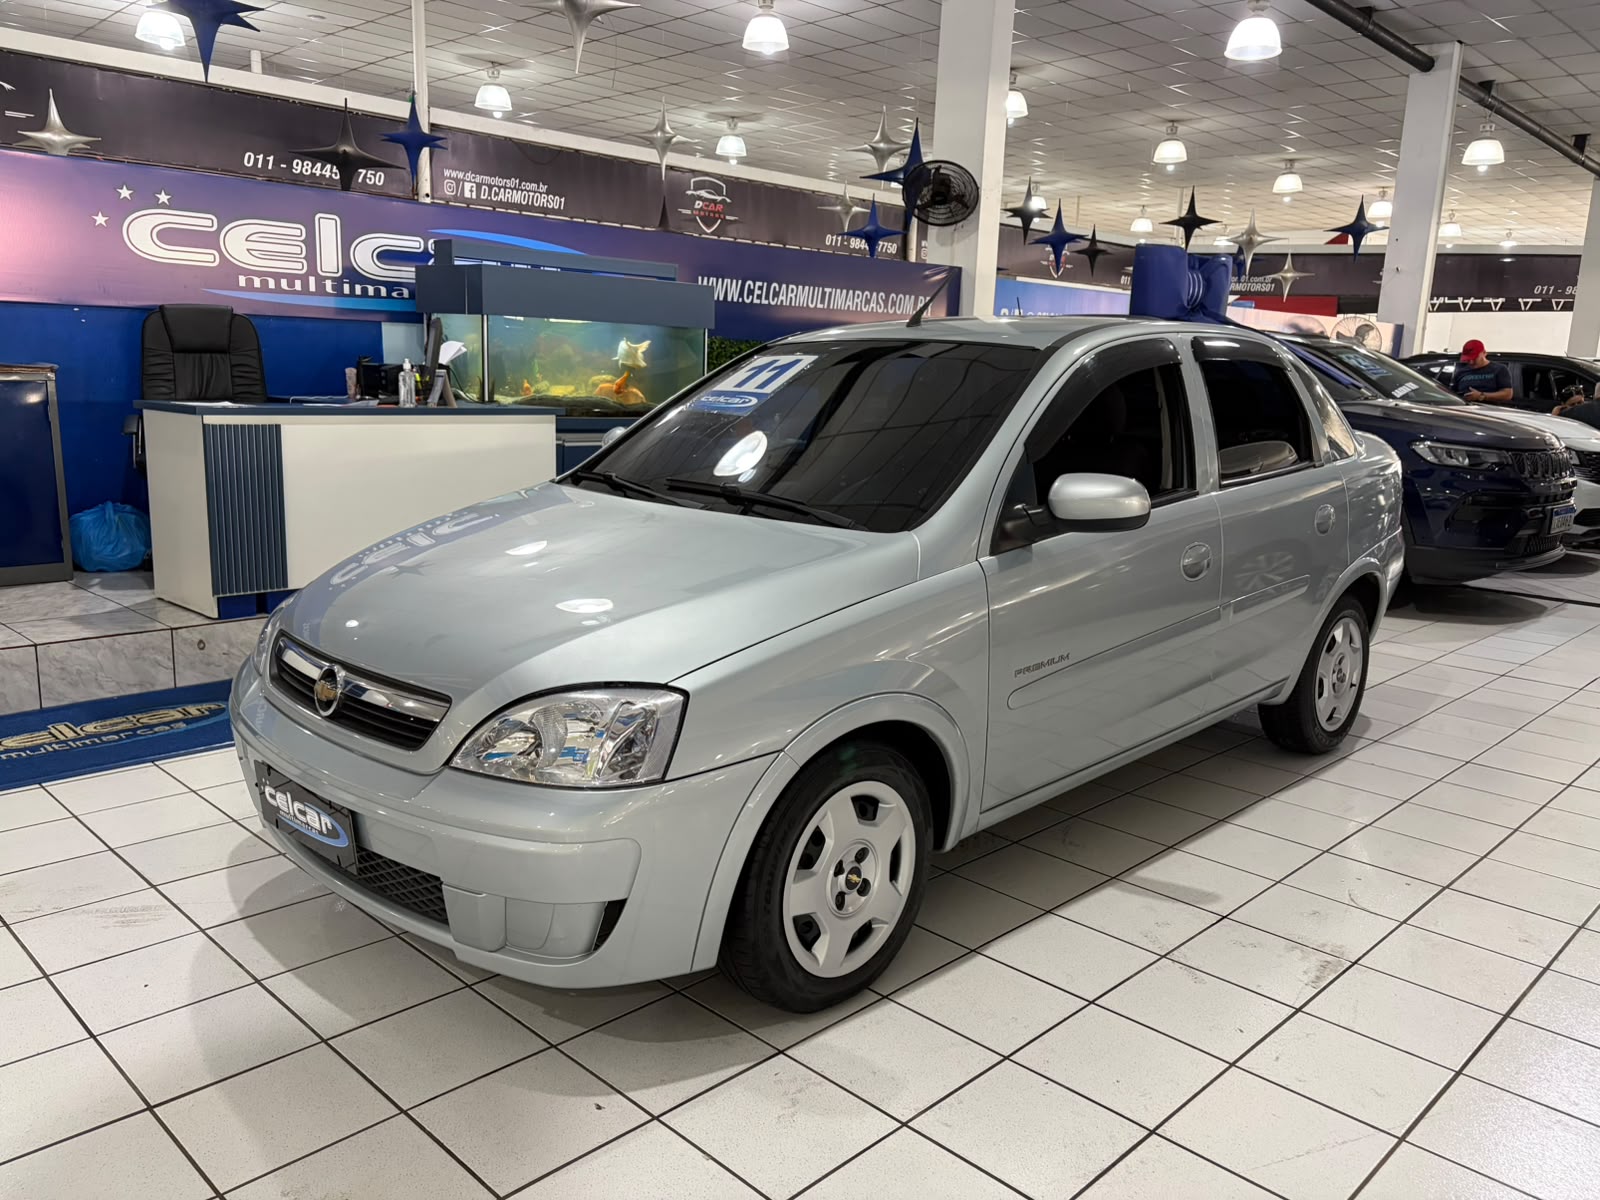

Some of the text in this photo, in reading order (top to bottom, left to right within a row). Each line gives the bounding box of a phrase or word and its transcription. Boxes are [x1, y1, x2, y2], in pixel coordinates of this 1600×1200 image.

[243, 152, 275, 170] 011
[443, 168, 548, 193] www.dcarmotors01.com.br
[480, 185, 565, 210] D.CARMOTORS01
[694, 200, 725, 212] DCAR
[122, 208, 436, 282] celc
[825, 234, 841, 247] 011
[238, 273, 410, 299] multima
[1533, 285, 1555, 295] 011
[733, 359, 804, 389] 11
[1014, 652, 1070, 678] PREMIUM
[265, 785, 333, 835] celcar
